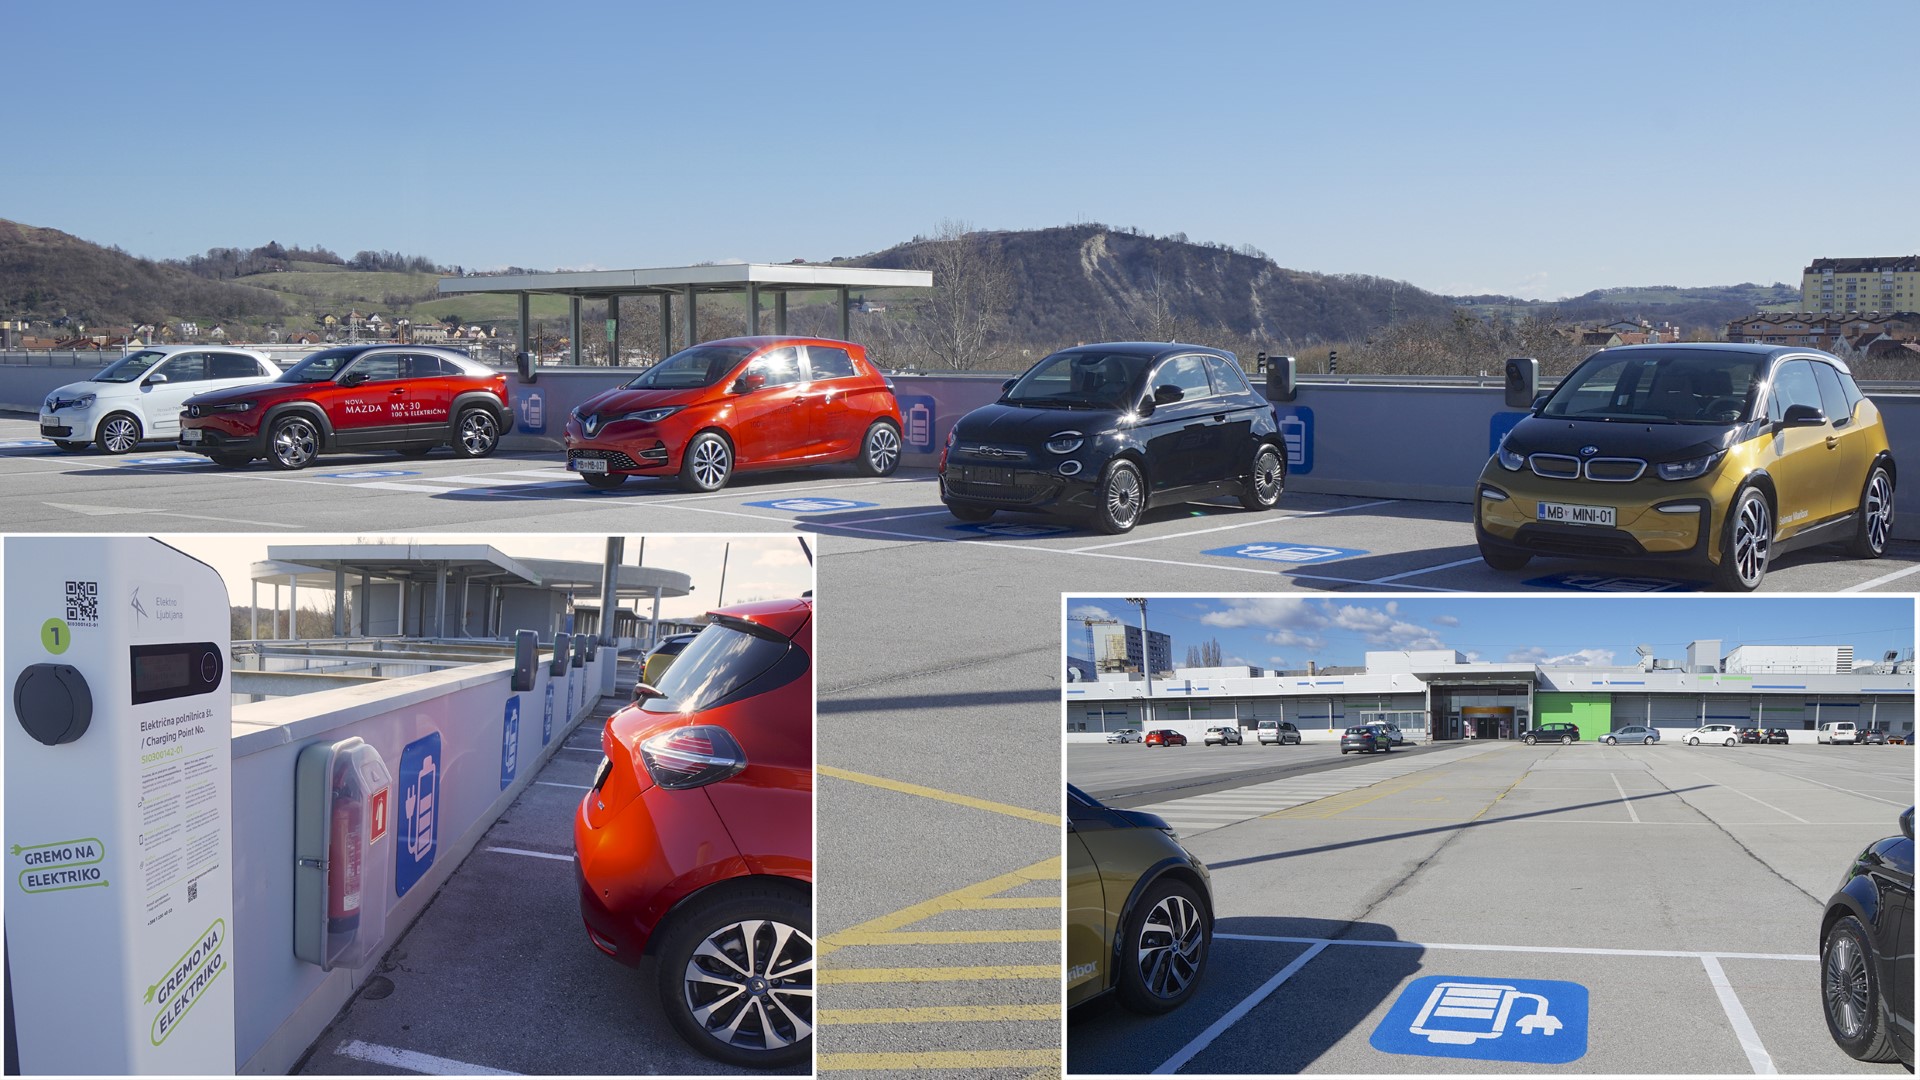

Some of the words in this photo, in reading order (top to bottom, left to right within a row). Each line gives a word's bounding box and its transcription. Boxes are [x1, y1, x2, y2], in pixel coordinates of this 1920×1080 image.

[345, 404, 382, 413] MAZDA
[391, 402, 421, 411] MX-30
[410, 408, 447, 416] ELEKTRIČNA
[1547, 505, 1564, 519] MB
[1573, 507, 1612, 523] MINI-01
[156, 596, 178, 607] Elektro
[156, 610, 183, 621] Ljubljana
[51, 626, 60, 646] 1
[140, 717, 175, 732] Električna
[175, 710, 206, 726] polnilnica
[146, 732, 177, 747] Charging
[177, 727, 194, 739] Point
[194, 724, 206, 734] No.
[25, 847, 73, 866] GREMO
[75, 845, 95, 859] NA
[27, 867, 101, 888] ELEKTRIKO
[158, 949, 201, 1005] GREMO
[203, 931, 218, 956] NA
[160, 953, 222, 1035] ELEKTRIKO
